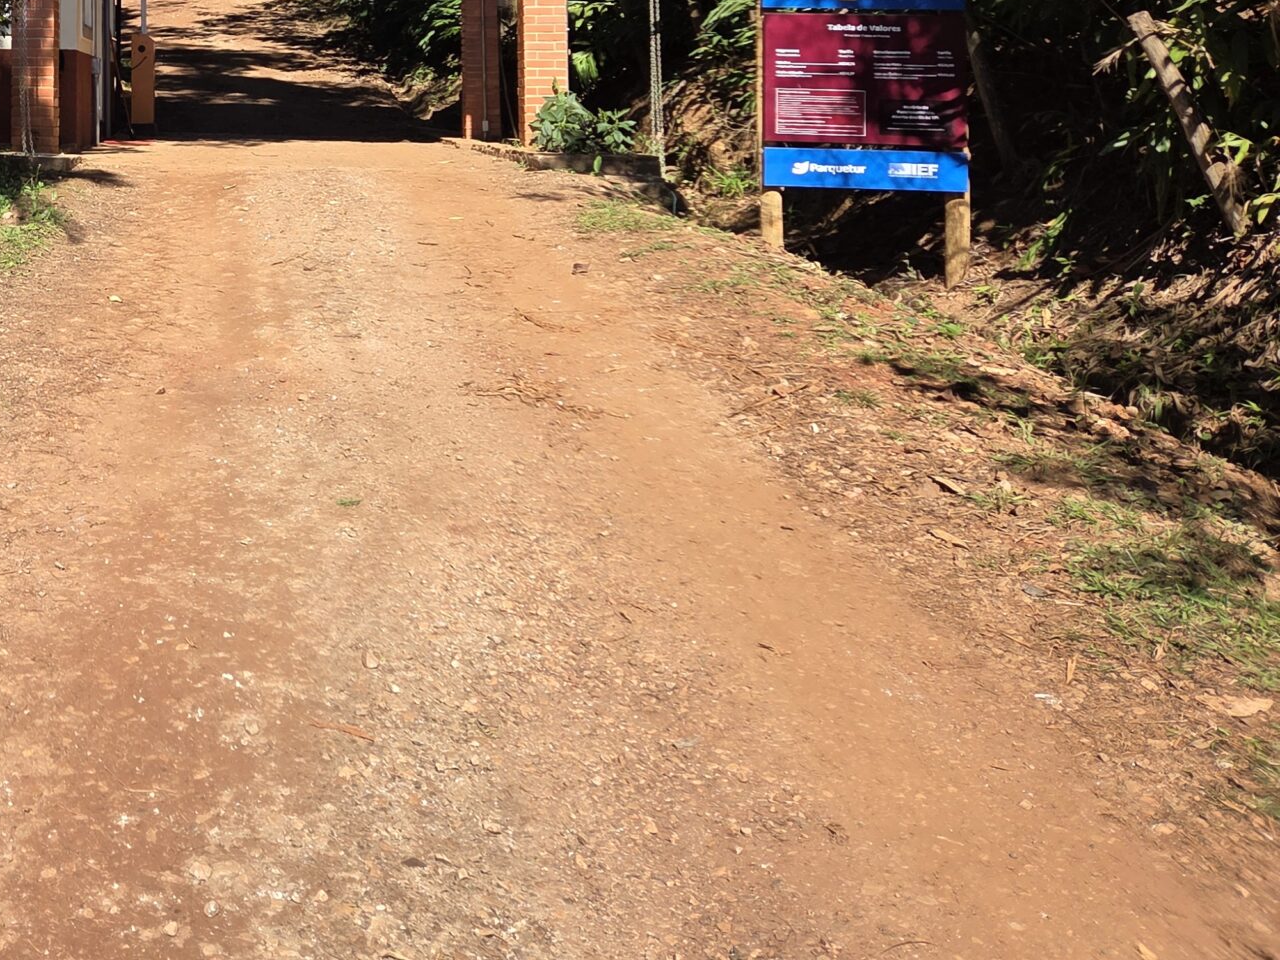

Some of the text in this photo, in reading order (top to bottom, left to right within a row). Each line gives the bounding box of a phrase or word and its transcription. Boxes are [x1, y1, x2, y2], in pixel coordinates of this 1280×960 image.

[826, 23, 855, 31] Tabela
[809, 162, 939, 176] Parquetur IEF
